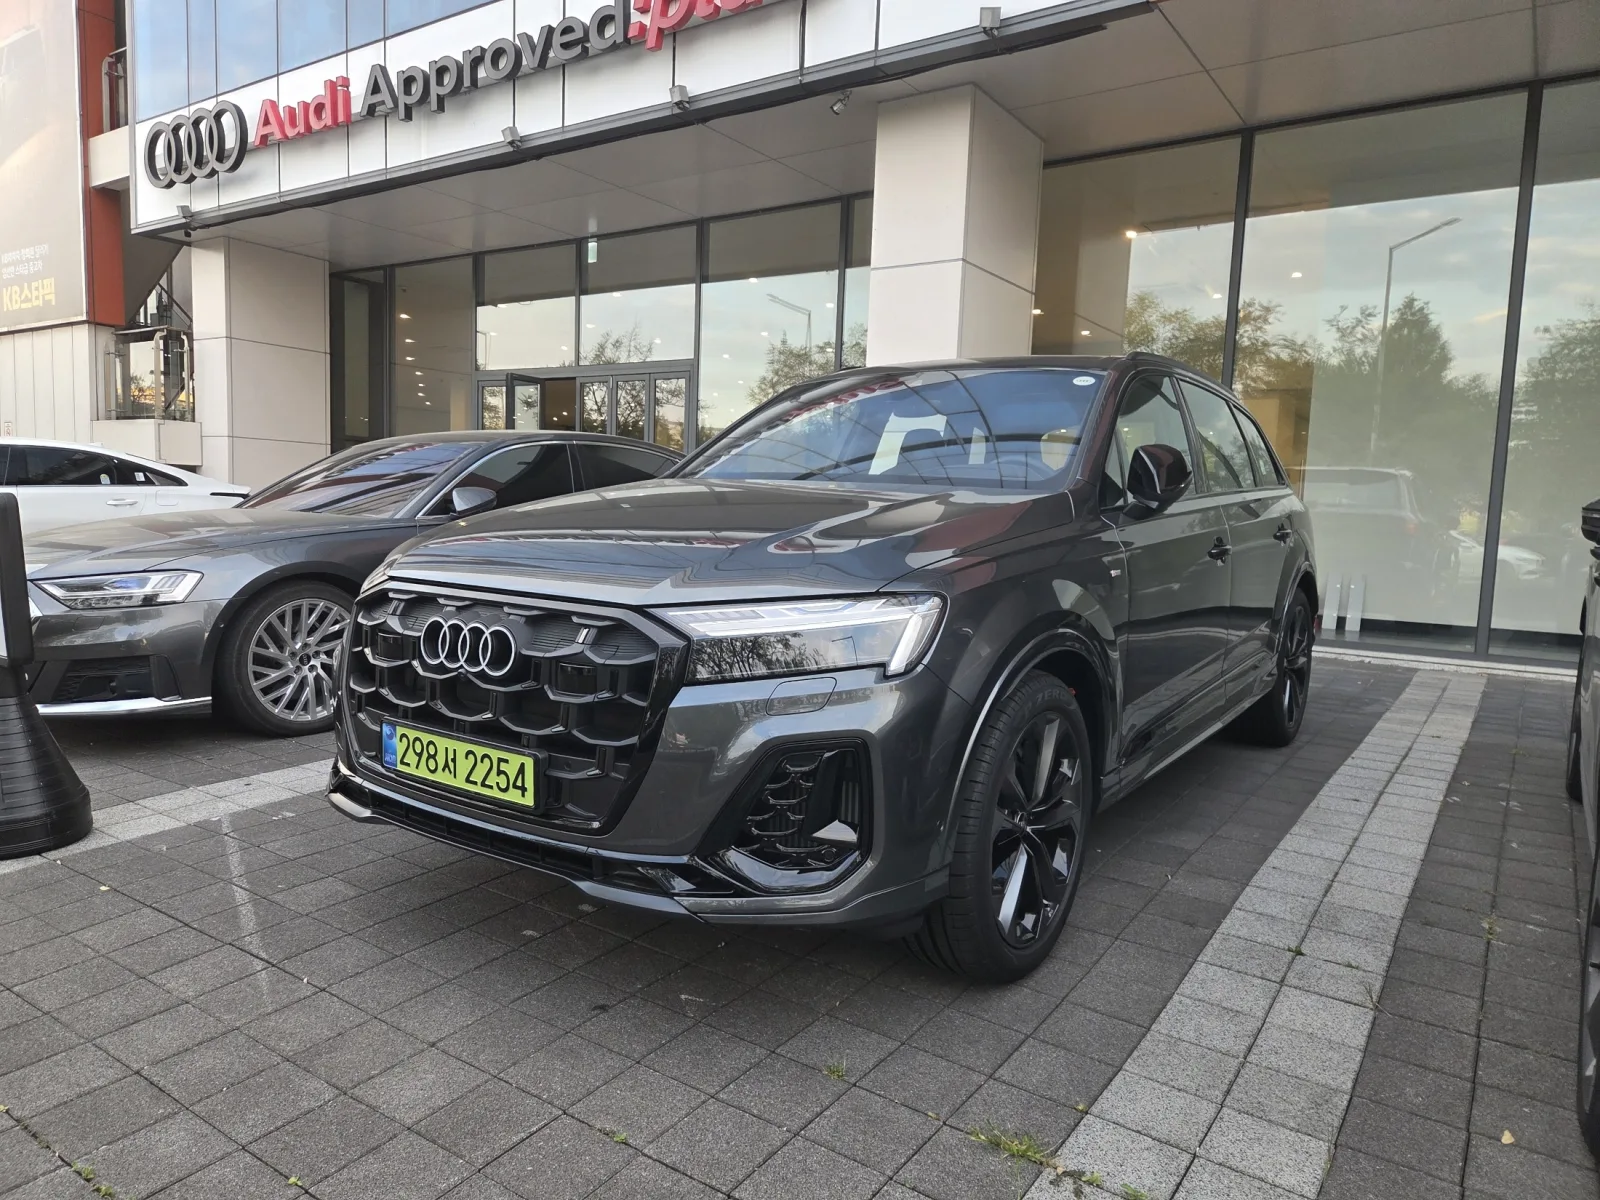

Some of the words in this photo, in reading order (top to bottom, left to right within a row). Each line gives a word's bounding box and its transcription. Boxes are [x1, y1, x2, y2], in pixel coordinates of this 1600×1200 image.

[254, 75, 352, 148] Audi
[3, 277, 55, 312] KB스타픽
[399, 732, 457, 780] 298서
[464, 749, 529, 799] 2254
